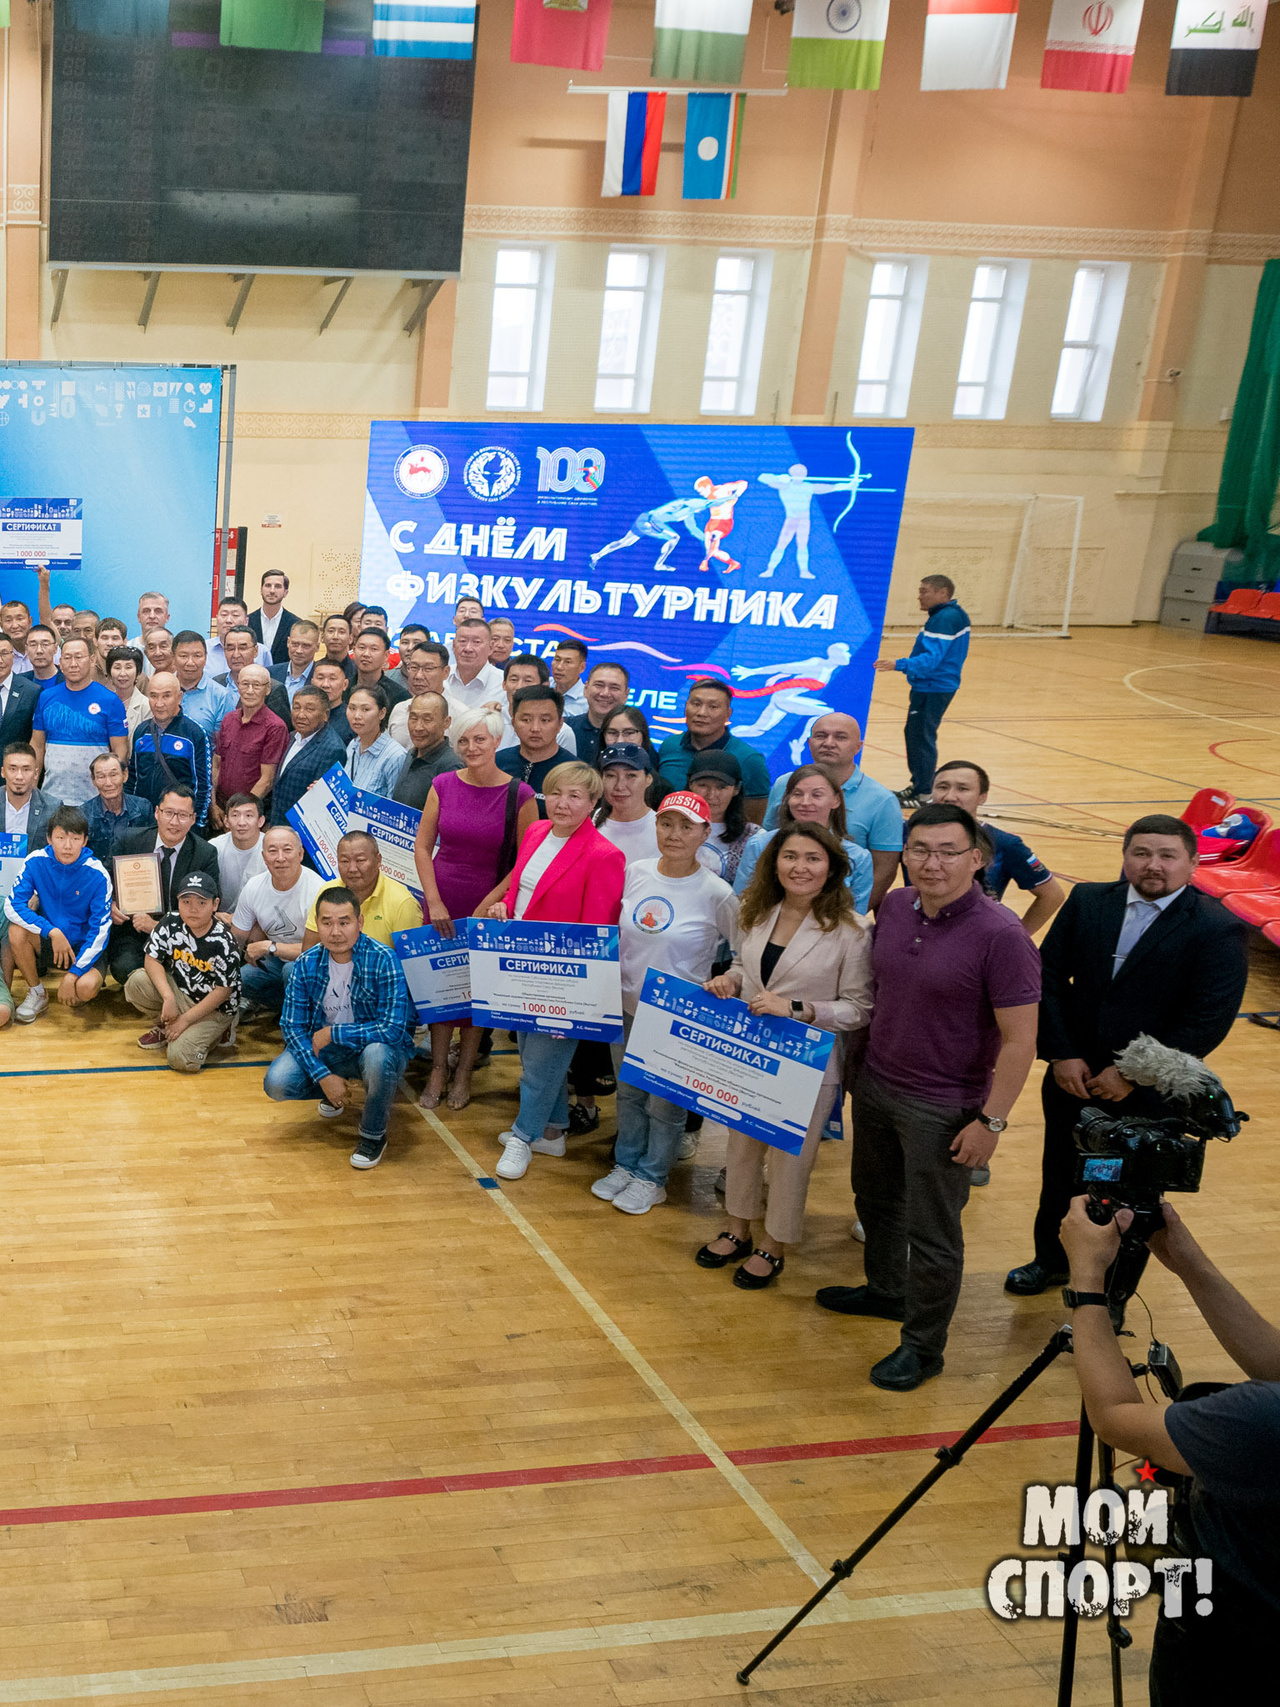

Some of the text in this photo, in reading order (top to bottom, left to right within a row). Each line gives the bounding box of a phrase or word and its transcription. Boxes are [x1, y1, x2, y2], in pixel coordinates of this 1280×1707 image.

[536, 446, 605, 493] 100
[390, 516, 568, 561] С ДНЁМ
[386, 570, 838, 630] ФИЗКУЛЬТУРНИКА
[625, 688, 678, 710] ЕЛЕ
[664, 796, 700, 812] RUSSIA
[371, 826, 415, 851] СЕРТИФИКА
[320, 840, 329, 854] 000
[327, 854, 337, 867] 000
[393, 870, 405, 880] 000
[437, 954, 470, 967] СЕРТИ
[505, 959, 579, 975] СЕРТИФИКАТ
[528, 1003, 545, 1013] 000
[548, 1005, 566, 1015] 000
[678, 1024, 770, 1070] СЕРТИФИКАТ
[684, 1075, 690, 1084] 1
[691, 1078, 714, 1094] 000
[716, 1088, 739, 1105] 000
